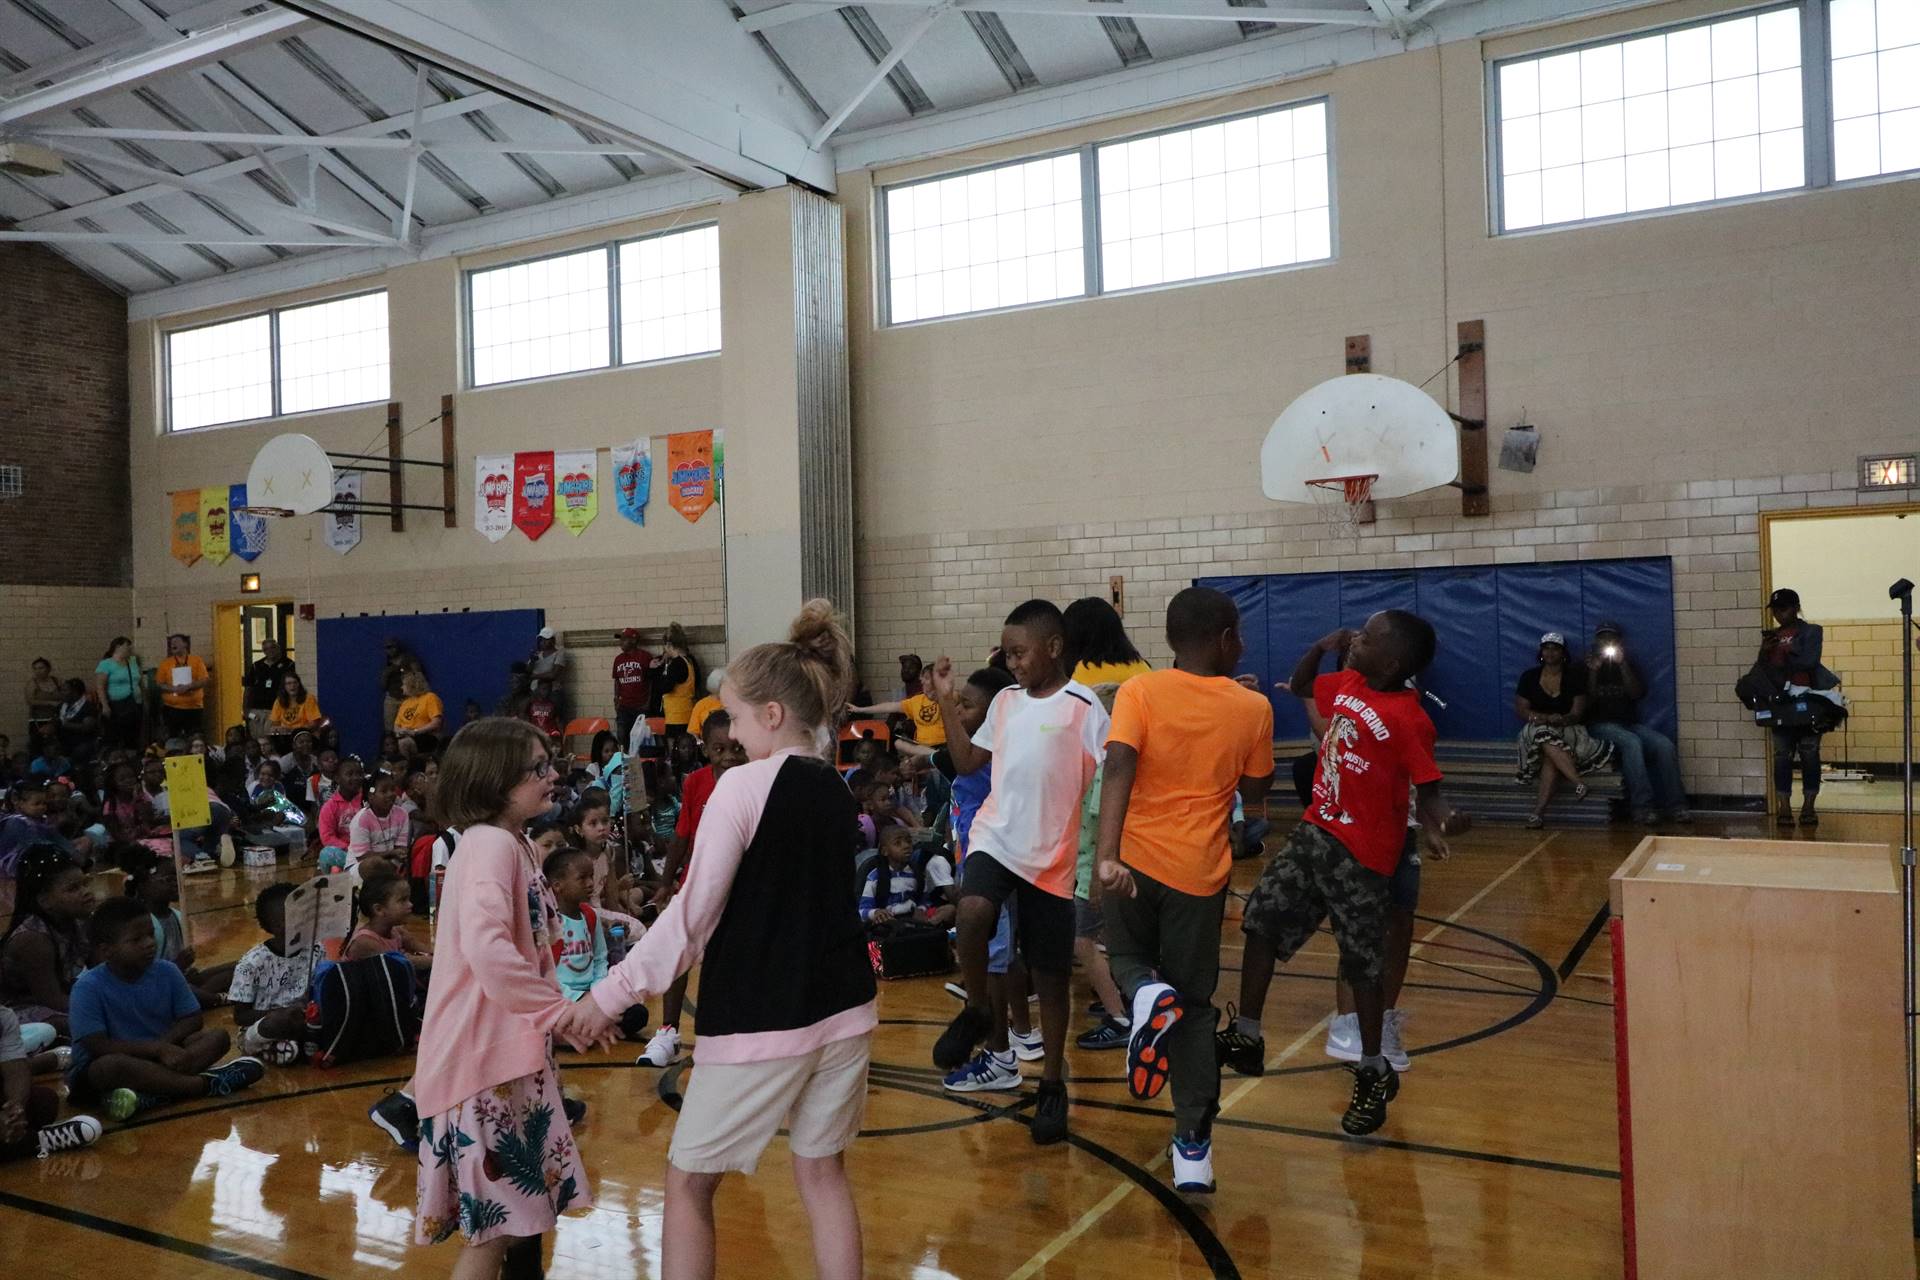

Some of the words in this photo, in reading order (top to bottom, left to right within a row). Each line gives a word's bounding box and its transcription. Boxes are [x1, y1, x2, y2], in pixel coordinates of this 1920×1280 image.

[1867, 460, 1913, 485] EXIT
[617, 662, 642, 672] ATLANTA
[1342, 696, 1366, 713] AND
[1360, 707, 1390, 741] GRIND
[1343, 751, 1370, 771] HUSTLE
